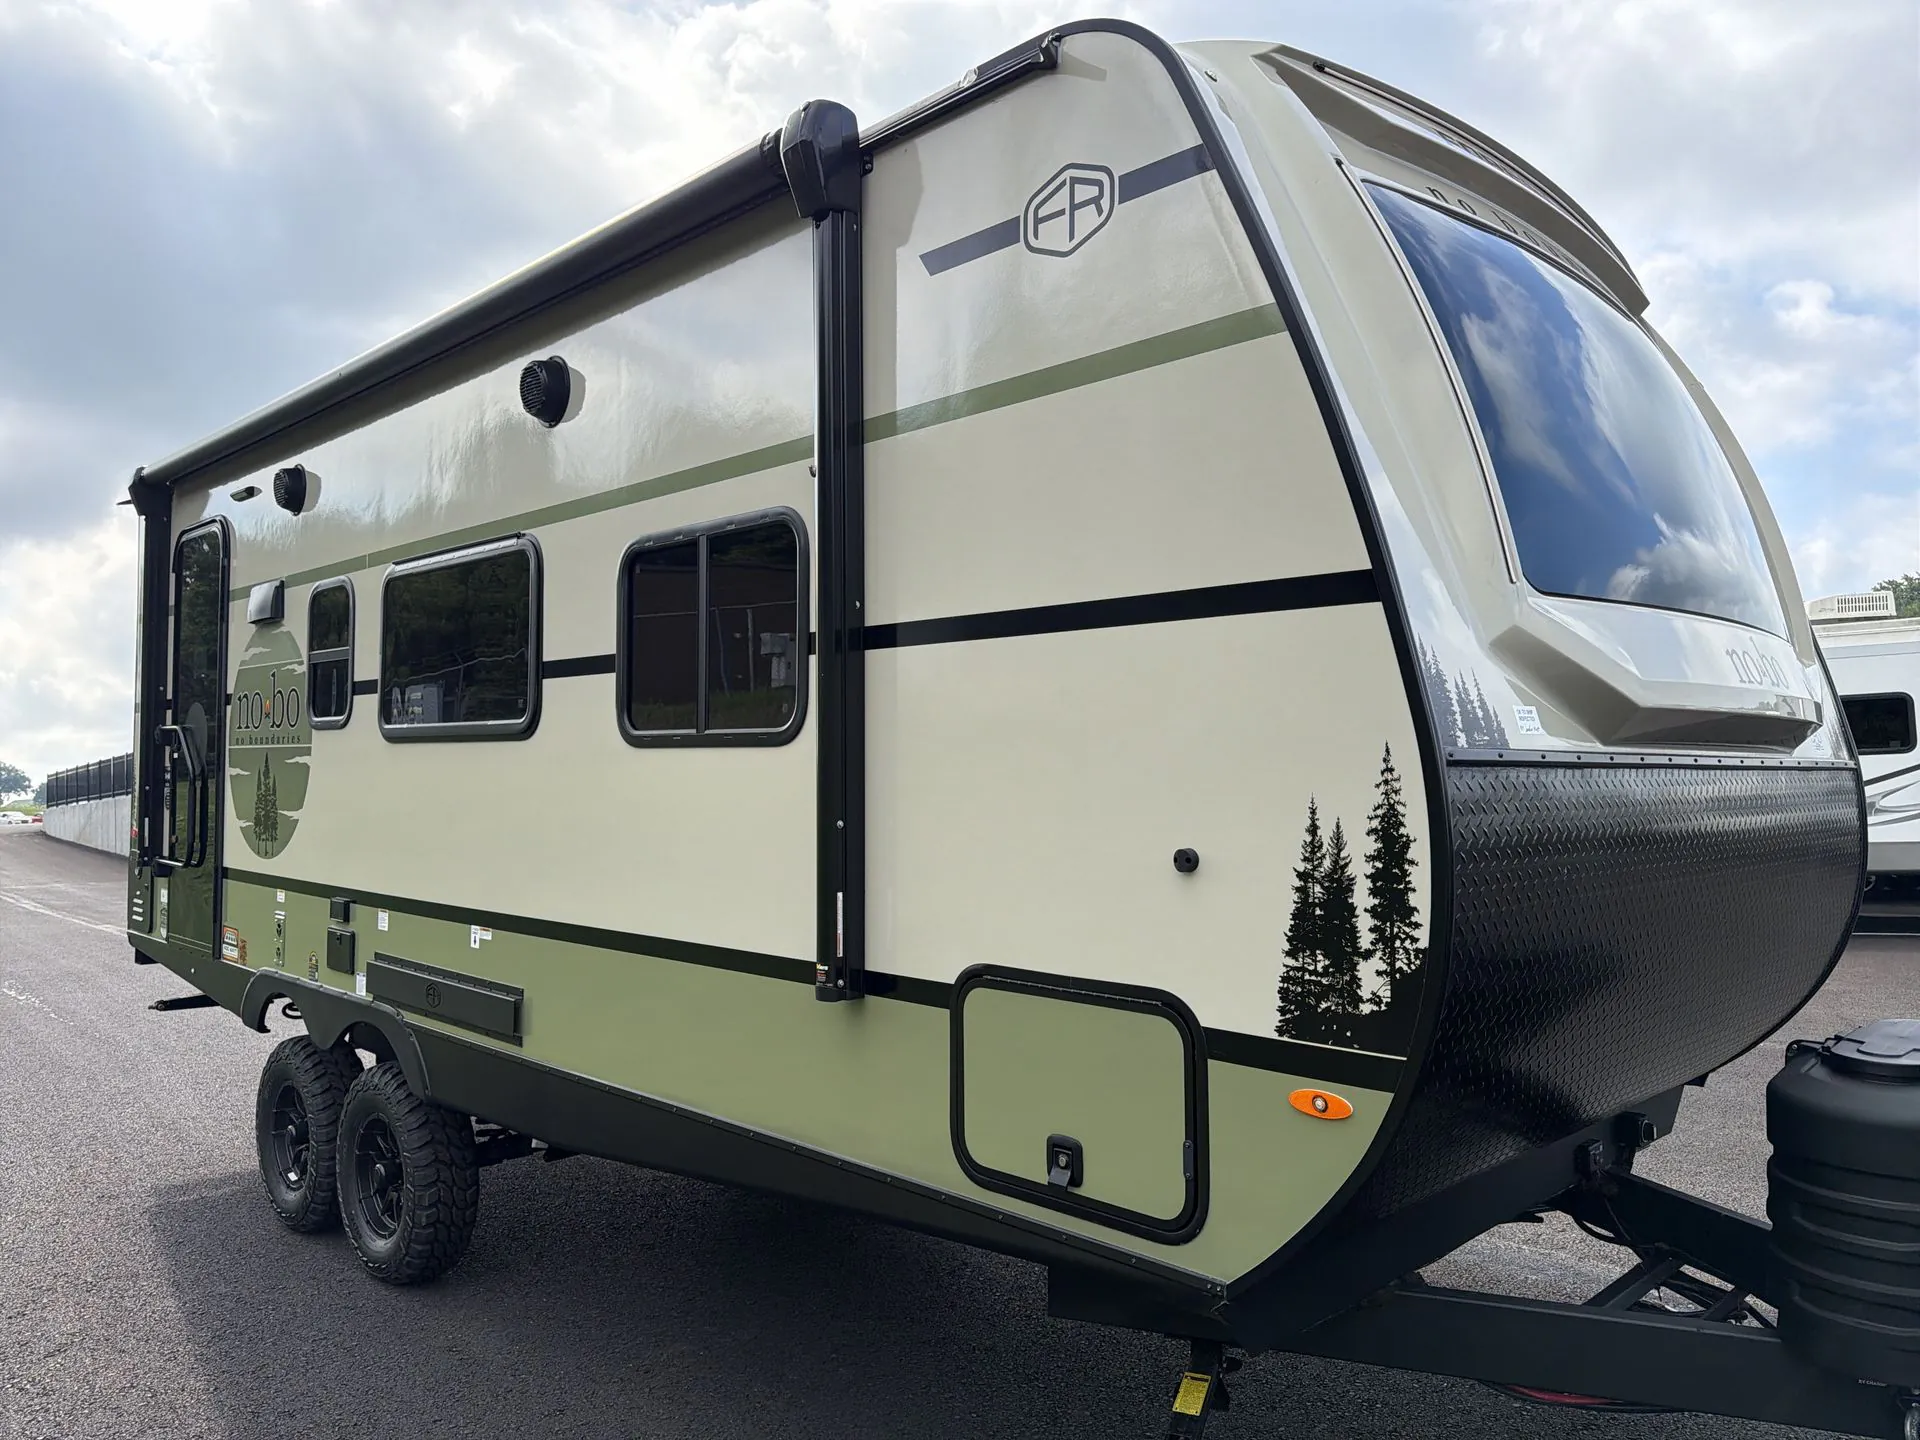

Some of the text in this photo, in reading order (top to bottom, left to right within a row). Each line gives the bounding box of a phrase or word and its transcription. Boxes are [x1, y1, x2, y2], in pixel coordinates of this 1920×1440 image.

[1032, 175, 1105, 244] FR
[235, 733, 302, 746] no boundaries
